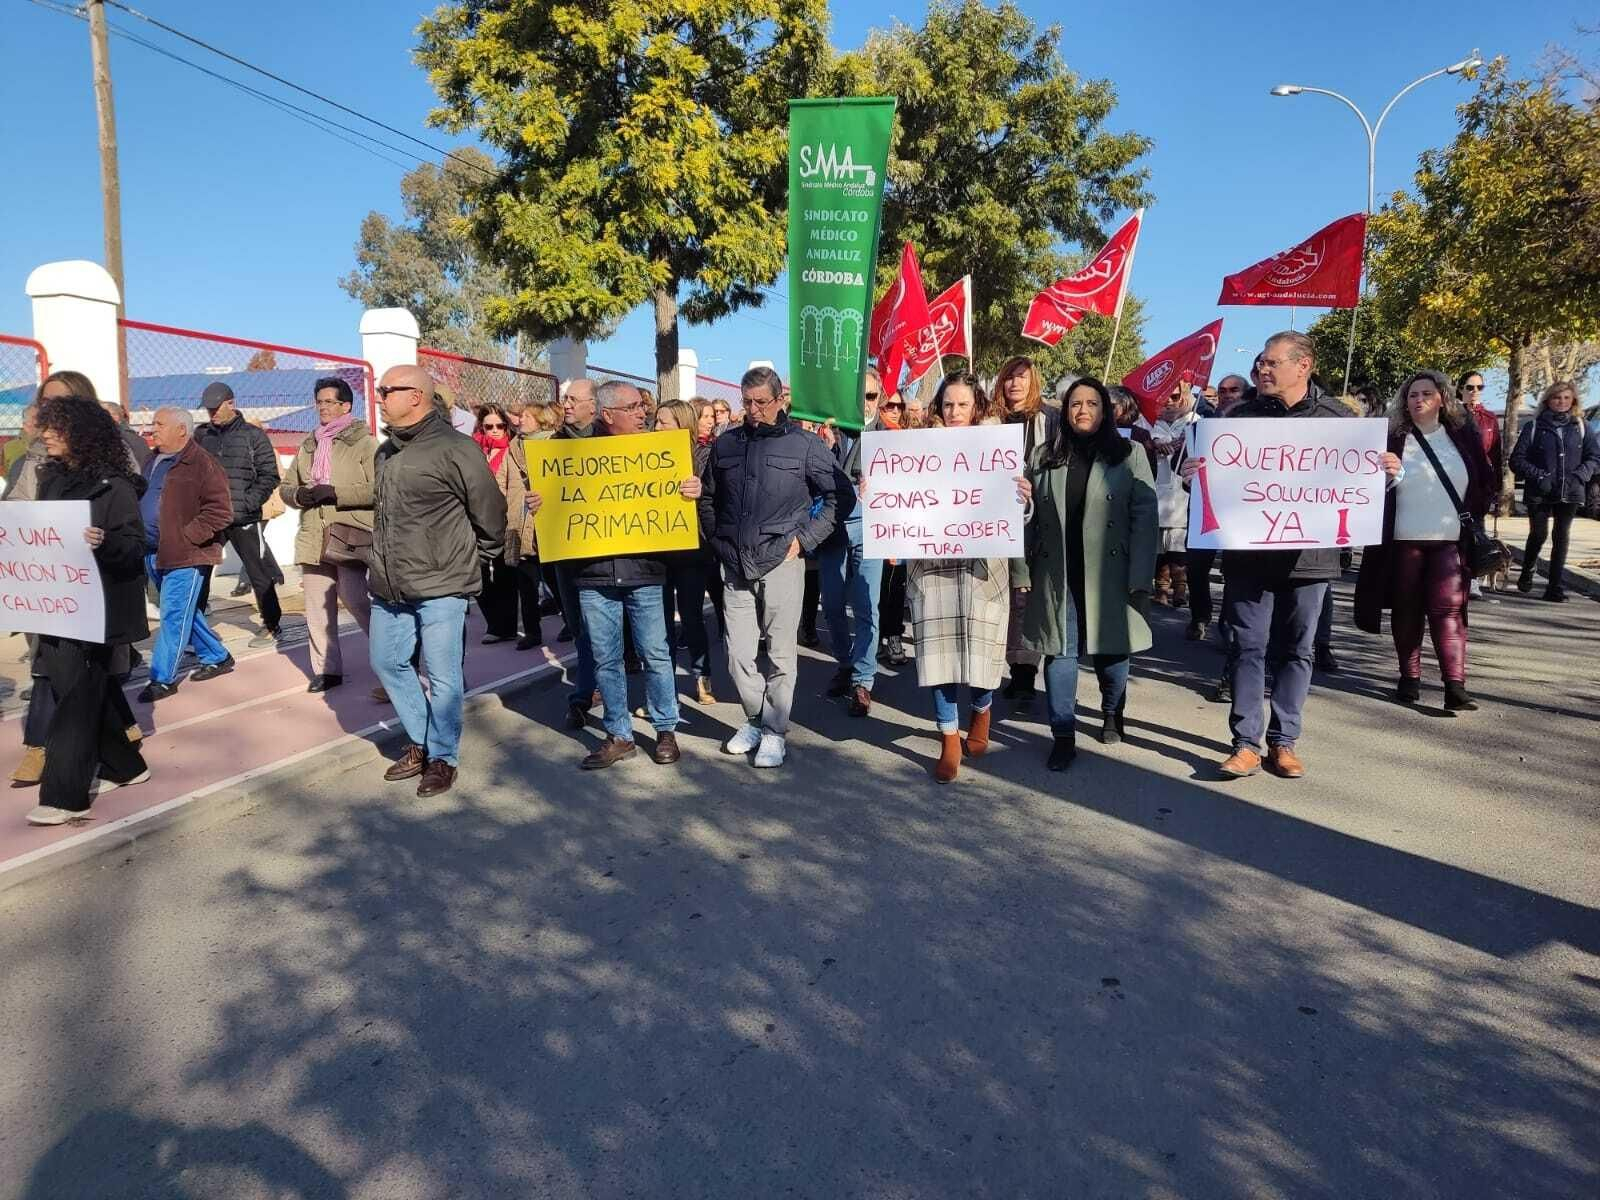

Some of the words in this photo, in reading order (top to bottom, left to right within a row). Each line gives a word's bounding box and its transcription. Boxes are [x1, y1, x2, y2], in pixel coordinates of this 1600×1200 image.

[799, 141, 855, 182] SMA
[803, 209, 869, 223] SINDICATO
[809, 226, 858, 242] MÉDICO
[806, 247, 862, 262] ANDALUZ
[801, 267, 865, 286] CÓRDOBA
[541, 450, 676, 477] MEJOREMOS
[869, 447, 942, 477] APOYO
[953, 452, 970, 472] A
[979, 447, 1018, 472] LAS
[1211, 433, 1379, 475] QUEREMOS
[560, 486, 587, 503] LA
[868, 489, 939, 510] ZONAS
[952, 488, 983, 506] DE
[1241, 480, 1371, 505] SOLUCIONES
[566, 509, 689, 542] PRIMARIA
[19, 527, 65, 549] UNA
[918, 542, 964, 556] TURA
[62, 564, 91, 585] DE
[2, 595, 80, 615] CALIDAD
